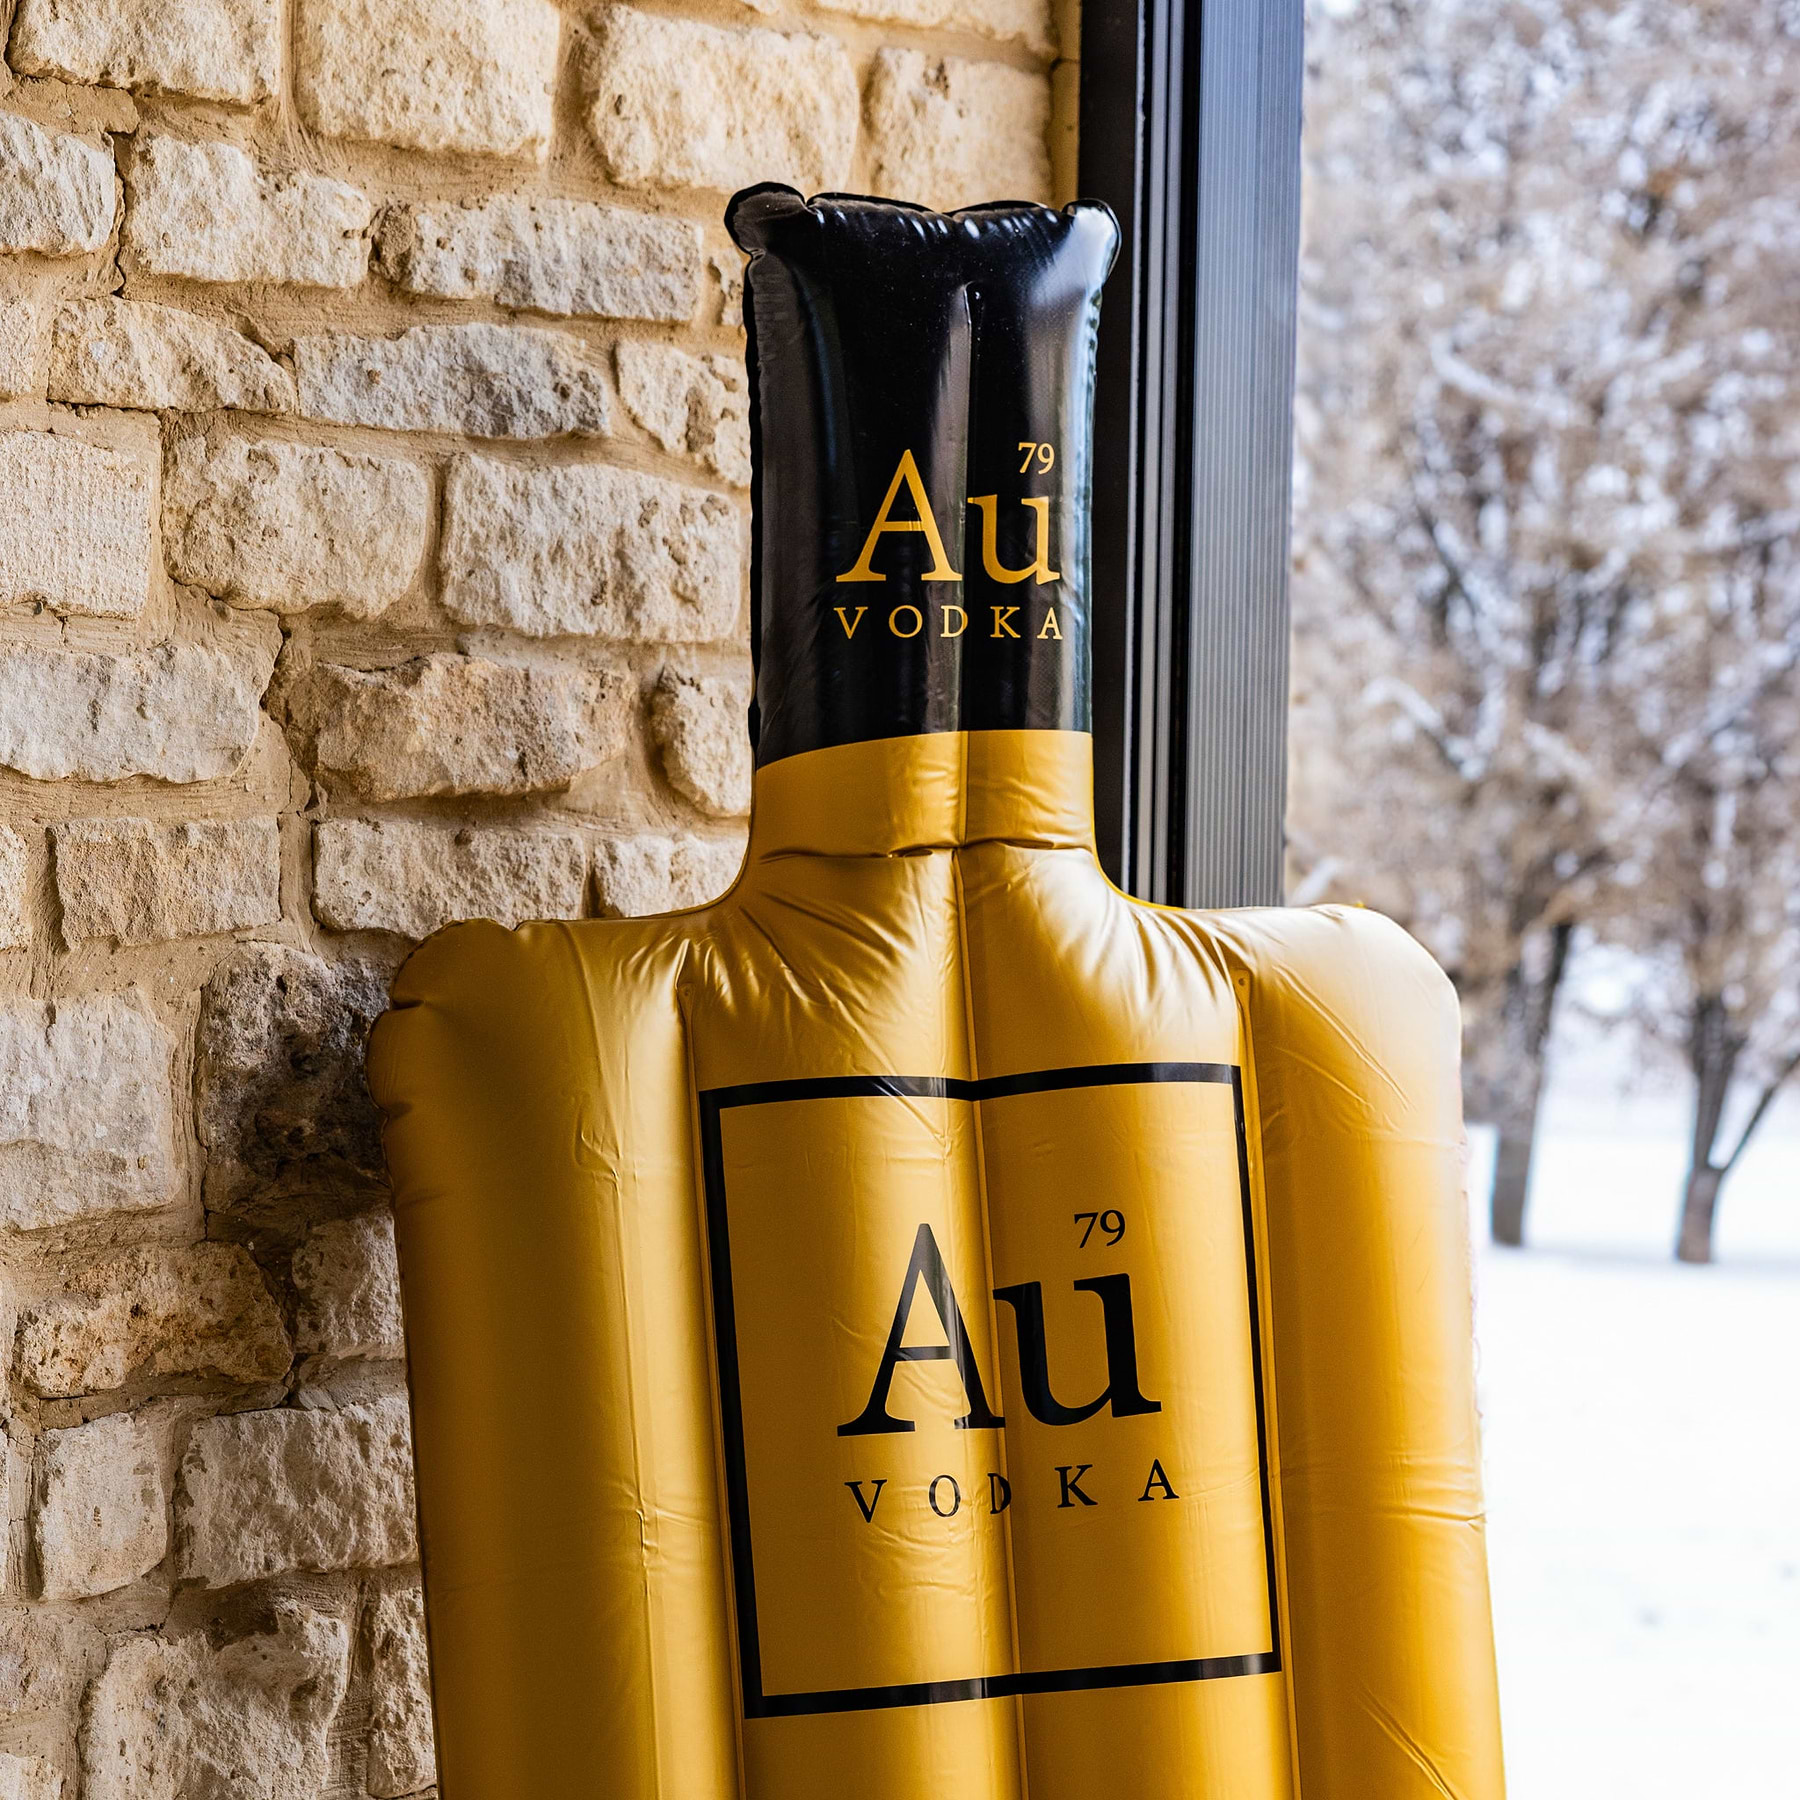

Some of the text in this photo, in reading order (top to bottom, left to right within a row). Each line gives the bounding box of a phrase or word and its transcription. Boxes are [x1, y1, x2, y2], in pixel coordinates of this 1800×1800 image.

[1017, 441, 1056, 476] 79
[835, 448, 1061, 586] Au
[833, 604, 1064, 640] VODKA
[1073, 1209, 1126, 1249] 79
[836, 1222, 1163, 1437] Au
[843, 1458, 1181, 1523] VODKA
